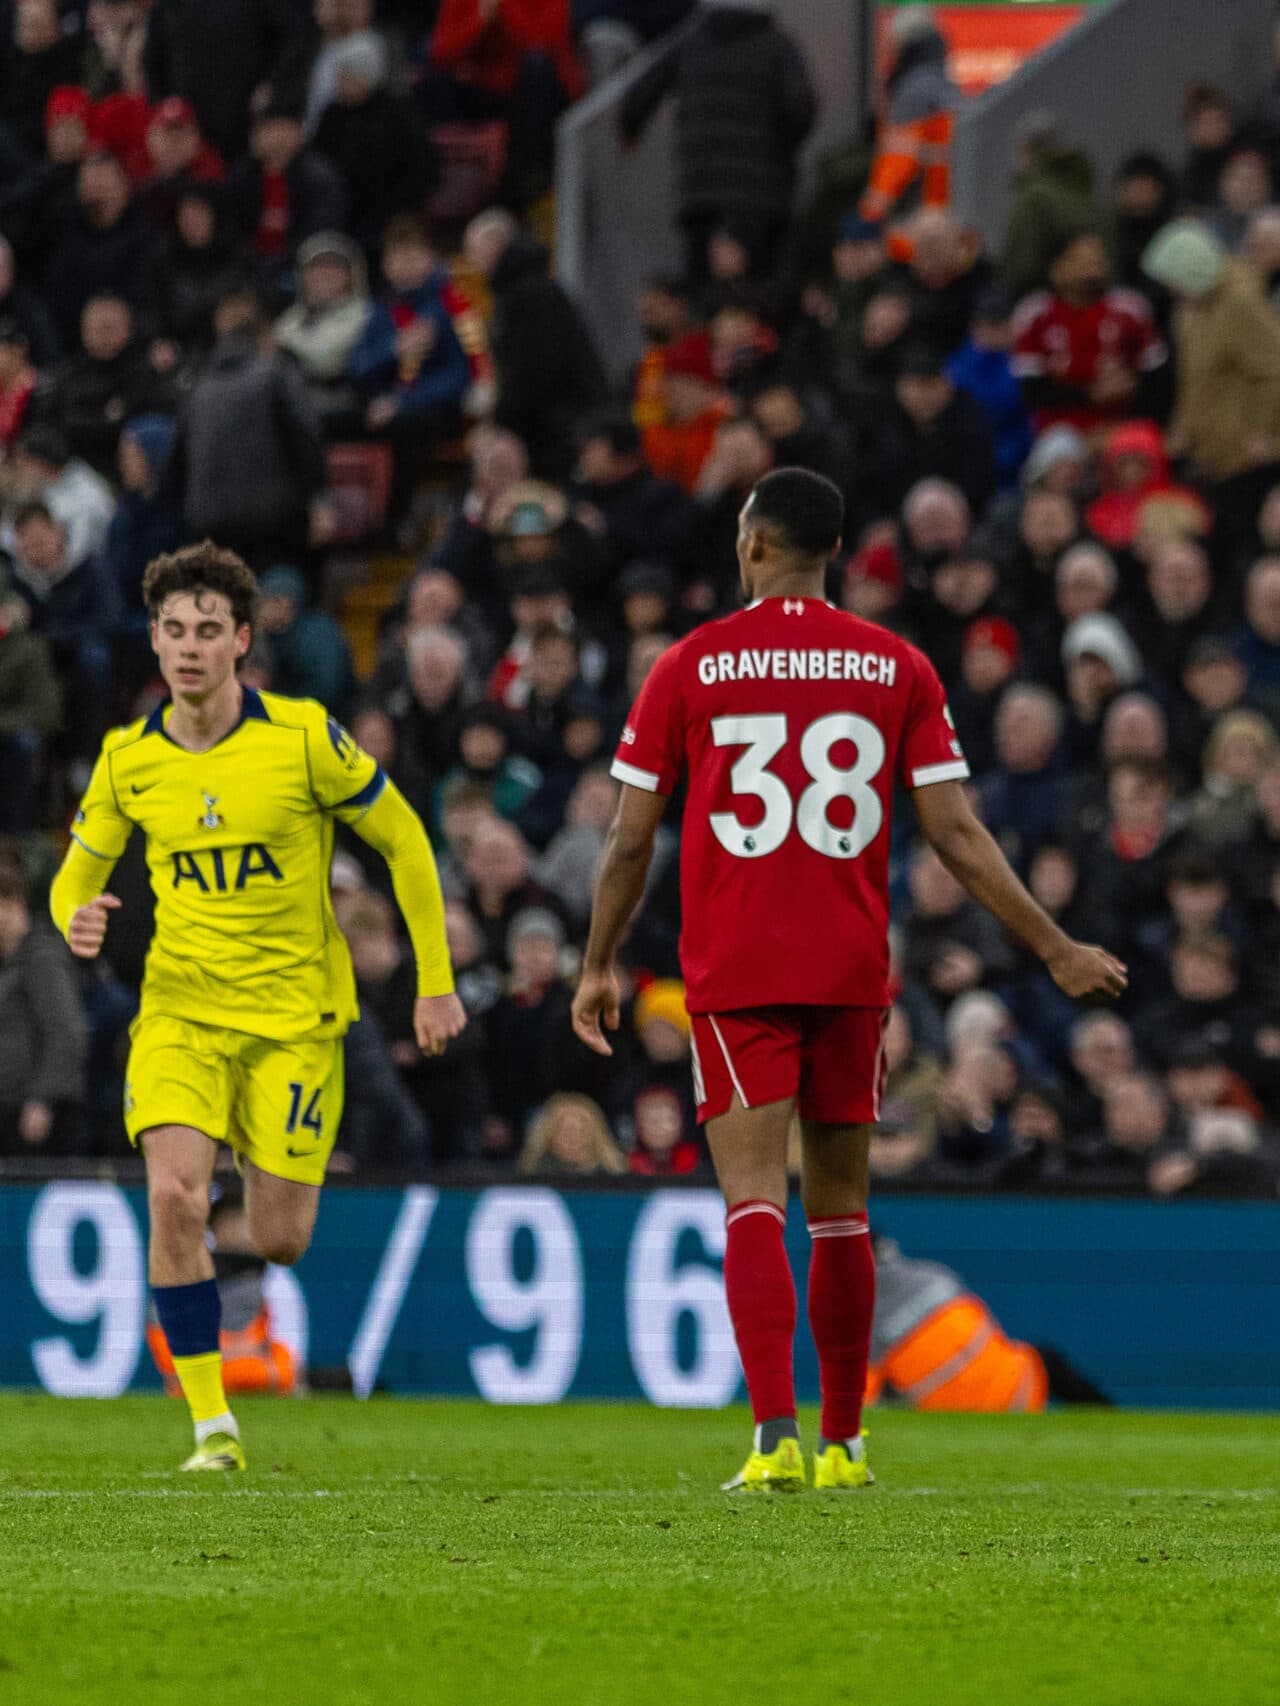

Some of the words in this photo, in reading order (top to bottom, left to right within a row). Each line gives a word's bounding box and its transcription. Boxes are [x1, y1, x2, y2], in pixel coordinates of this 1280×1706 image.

[698, 649, 897, 687] GRAVENBERCH
[709, 711, 885, 859] 38
[172, 842, 284, 893] AIA
[286, 1082, 322, 1140] 14
